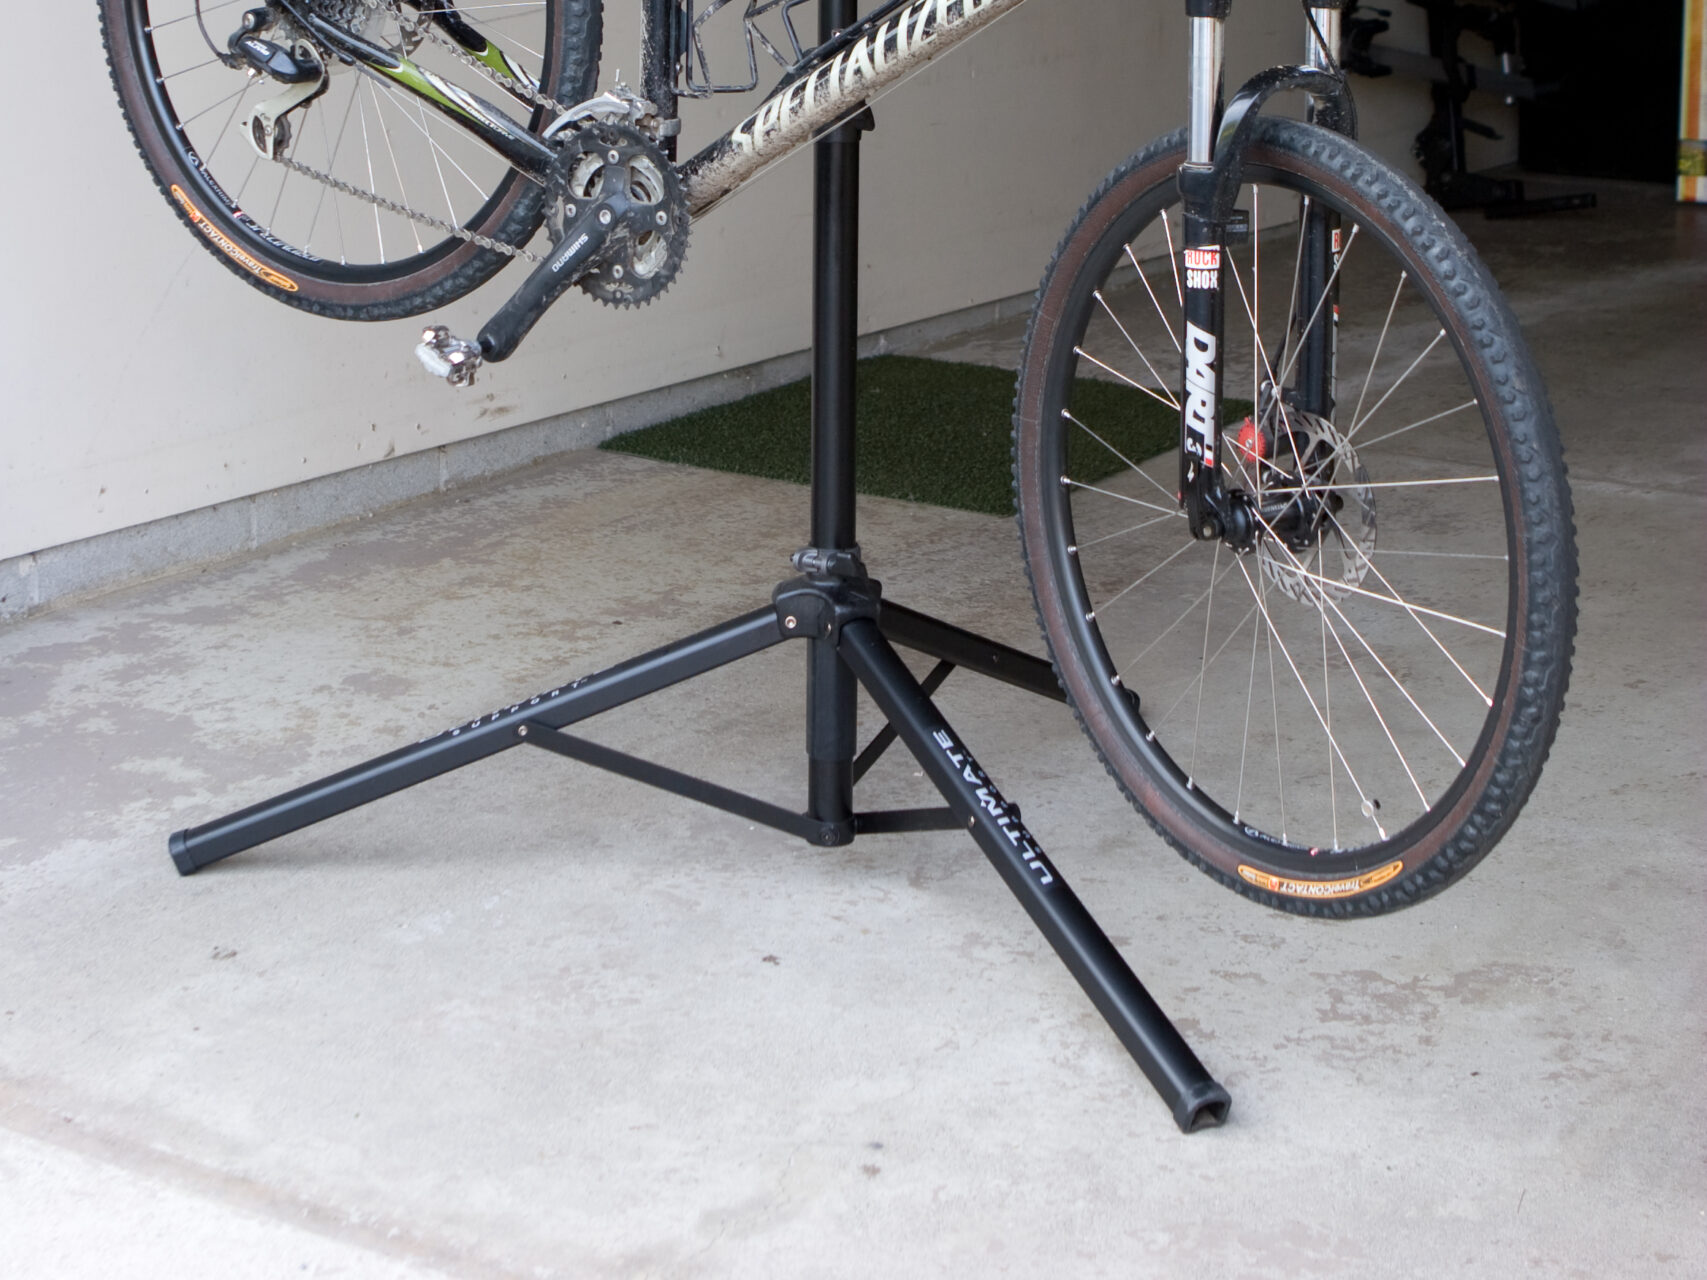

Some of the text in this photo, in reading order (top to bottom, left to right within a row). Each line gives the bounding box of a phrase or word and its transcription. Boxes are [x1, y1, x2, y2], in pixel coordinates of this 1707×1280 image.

[551, 232, 589, 273] SHIMANO
[1187, 250, 1218, 266] ROCK
[1187, 270, 1218, 289] SHOX
[1185, 321, 1217, 446] DART
[933, 729, 1053, 886] ULTIMATE
